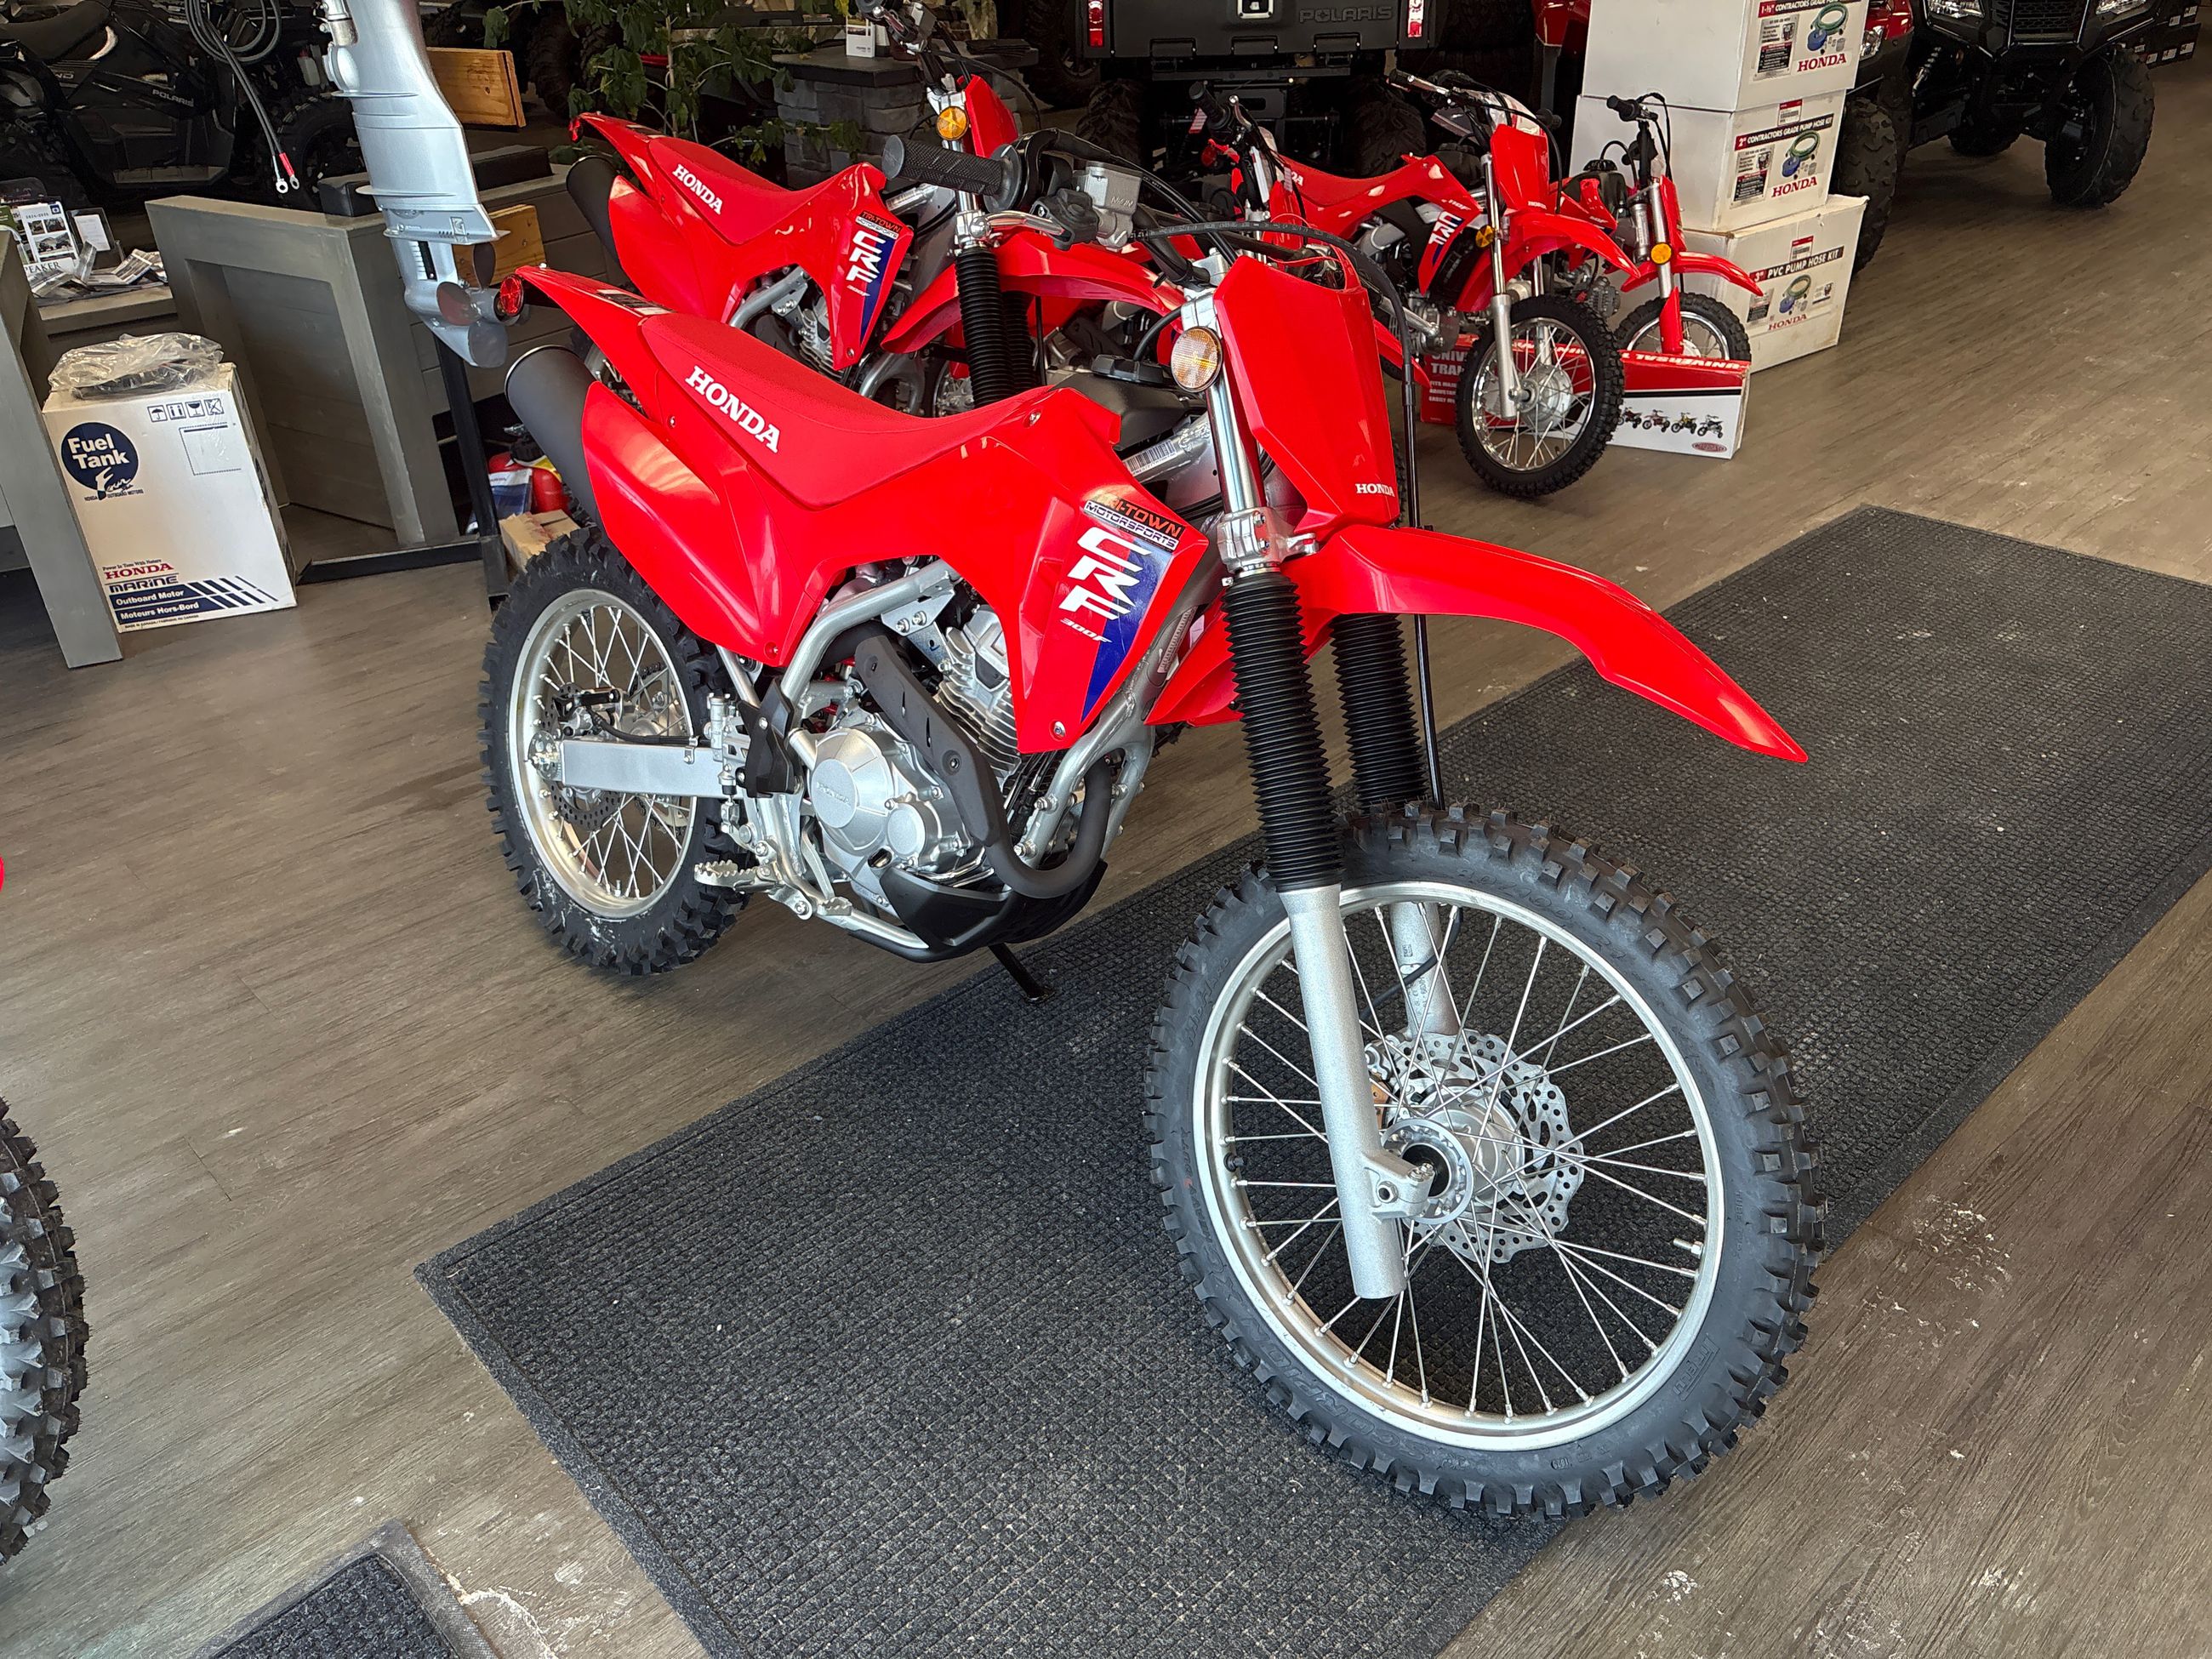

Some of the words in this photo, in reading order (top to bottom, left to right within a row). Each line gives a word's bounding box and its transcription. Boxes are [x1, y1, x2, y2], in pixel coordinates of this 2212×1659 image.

[1299, 6, 1393, 24] POLARIS
[1797, 53, 1847, 72] HONDA
[152, 88, 194, 107] POLARIS
[1747, 129, 1782, 145] CONTRACTORS
[672, 163, 722, 215] HONDA
[1771, 176, 1818, 197] HONDA
[857, 217, 898, 238] MOTORSPORTS
[862, 211, 900, 232] TRI-TOWN
[1428, 211, 1462, 245] CRF
[846, 231, 887, 283] CRF
[1754, 271, 1764, 282] 3"
[1768, 267, 1784, 279] PVC
[1785, 259, 1806, 274] PUMP
[1808, 254, 1827, 267] HOSE
[1827, 249, 1839, 260] KIT
[1769, 314, 1807, 330] HONDA
[685, 364, 780, 453] HONDA
[68, 433, 114, 453] Fuel
[72, 449, 129, 469] Tank
[1355, 482, 1395, 497] HONDA
[1086, 502, 1177, 549] MOTORSPORTS
[105, 562, 174, 579] HONDA
[1058, 526, 1153, 621] CRF
[109, 575, 179, 593] MARINE
[117, 593, 157, 606] Outboard
[159, 590, 185, 599] Motor
[121, 609, 156, 619] Moteurs
[157, 601, 199, 614] Hors-Bord
[1060, 617, 1113, 643] 300F
